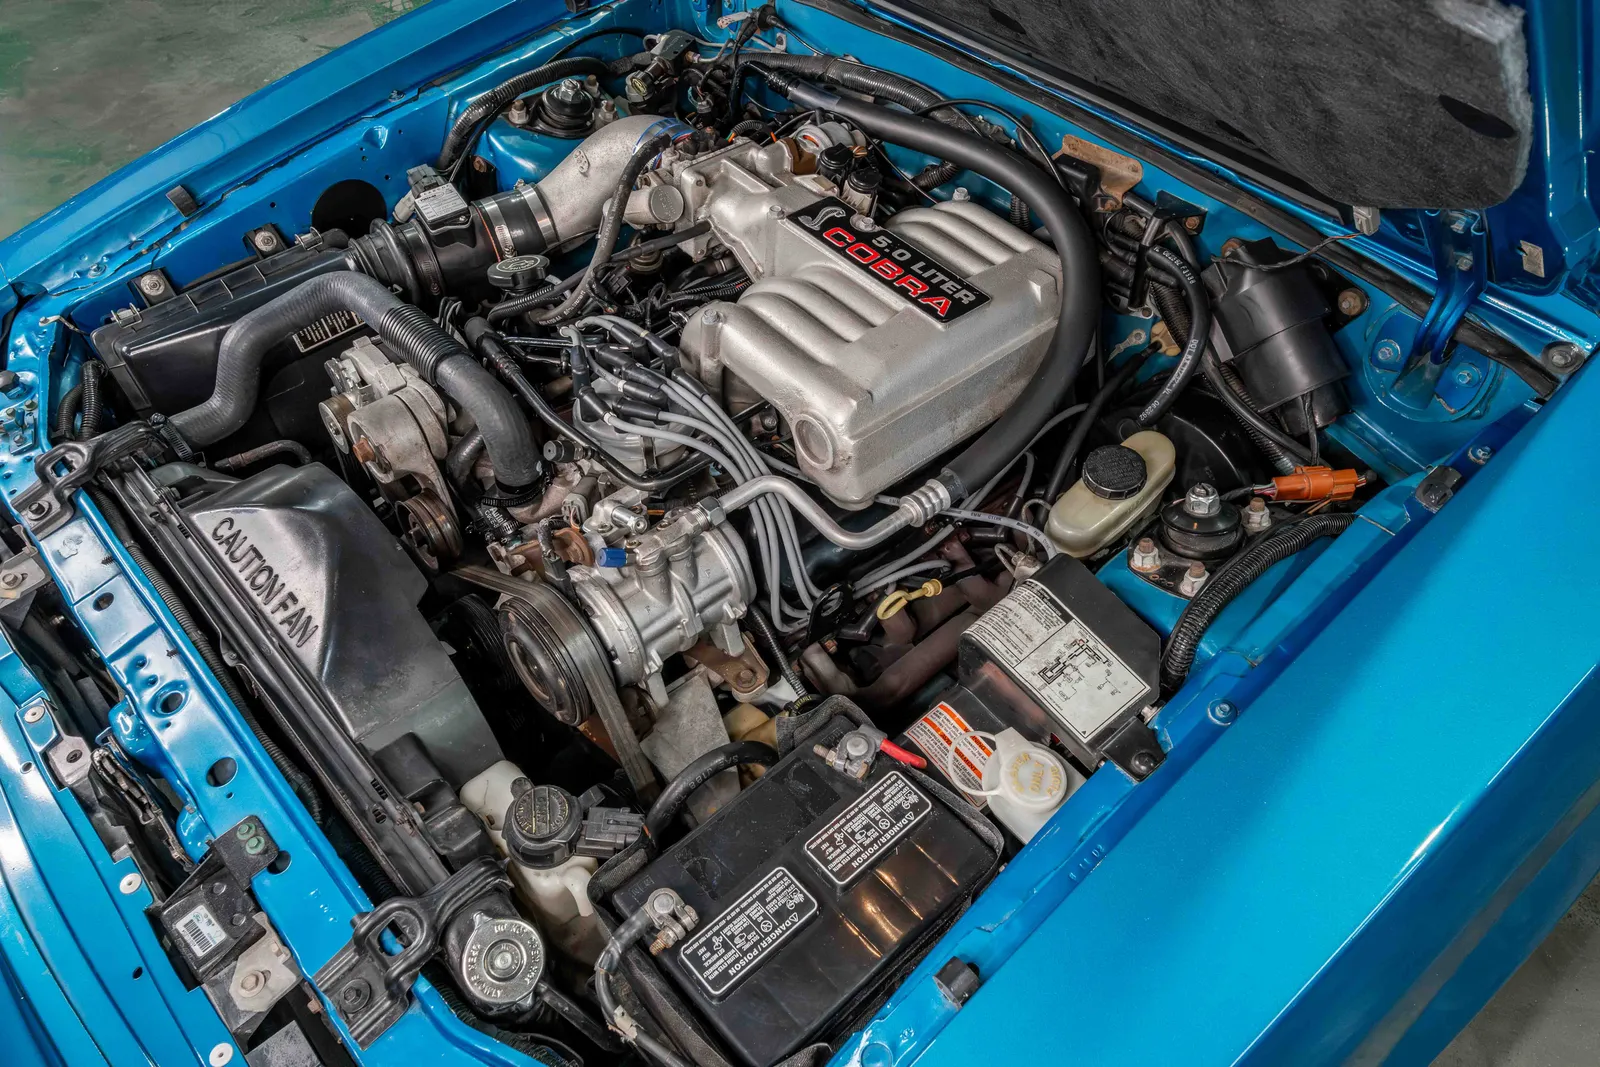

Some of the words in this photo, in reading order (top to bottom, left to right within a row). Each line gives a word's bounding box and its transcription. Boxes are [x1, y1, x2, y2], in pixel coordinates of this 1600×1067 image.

[823, 227, 952, 317] COBRA
[872, 235, 912, 262] 5.0
[910, 261, 977, 305] LITER
[212, 517, 286, 605] CAUTION
[271, 591, 319, 648] FAN
